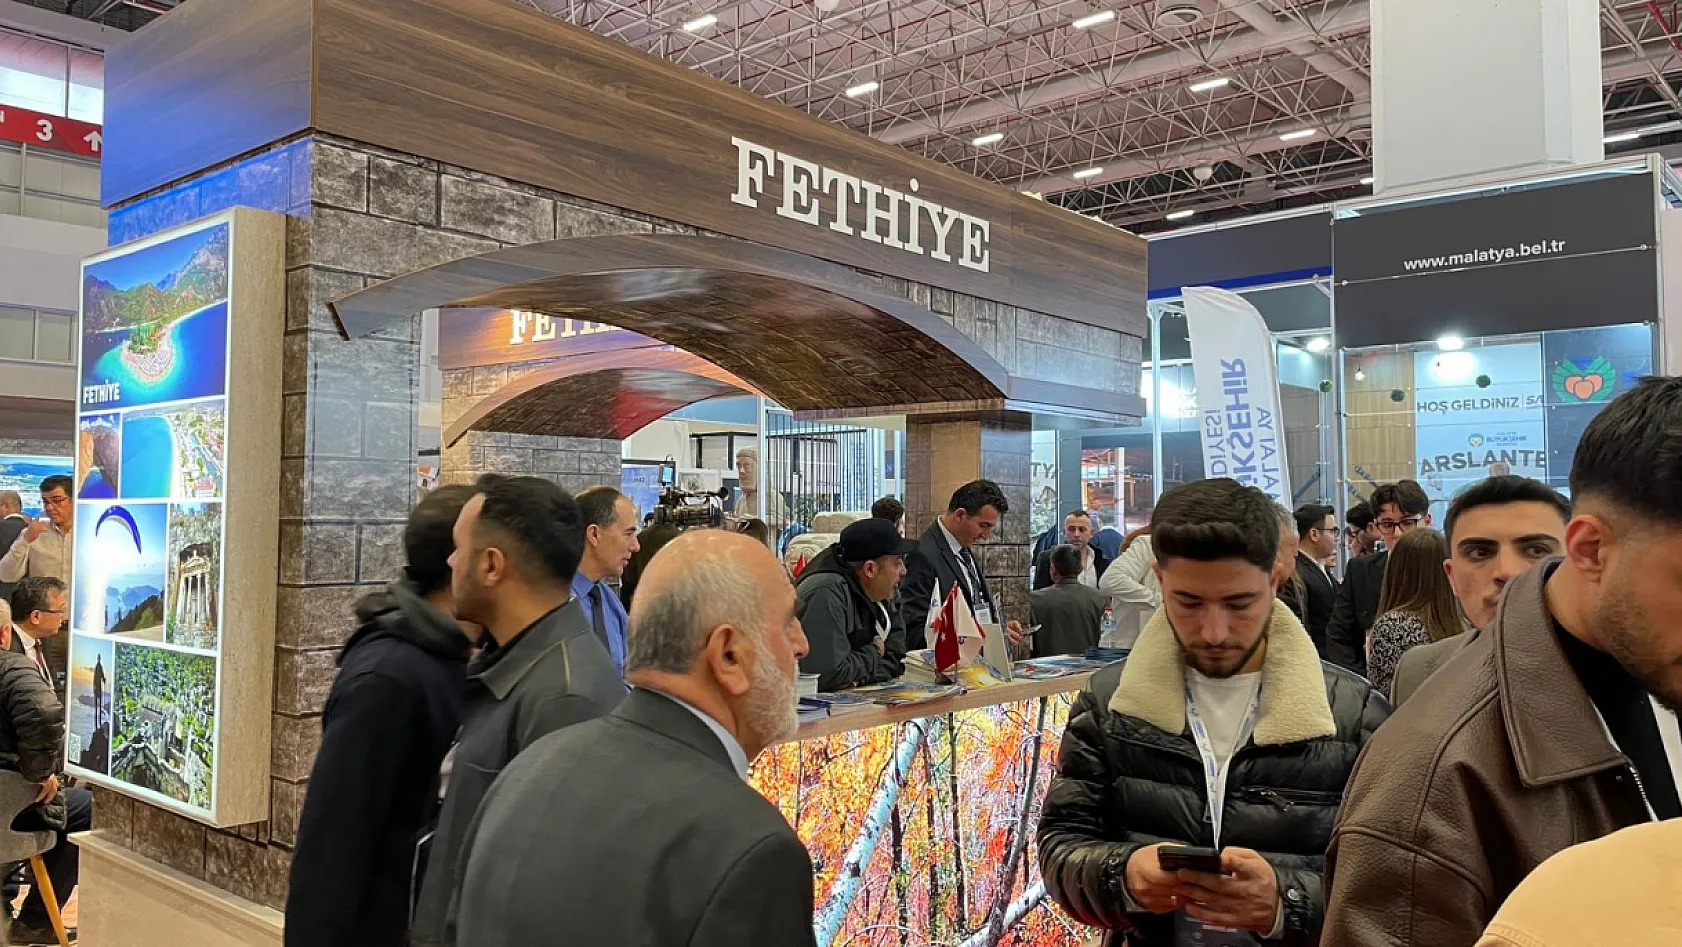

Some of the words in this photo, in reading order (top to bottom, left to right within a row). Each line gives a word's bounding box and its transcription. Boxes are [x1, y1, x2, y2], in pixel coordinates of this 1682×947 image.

[36, 119, 53, 142] 3
[731, 136, 990, 273] FETHİYE
[1403, 239, 1567, 270] www.malatya.bel.tr
[82, 378, 120, 404] FETHİYE
[1417, 400, 1448, 414] HOŞ
[1451, 397, 1519, 411] GELDİNİZ
